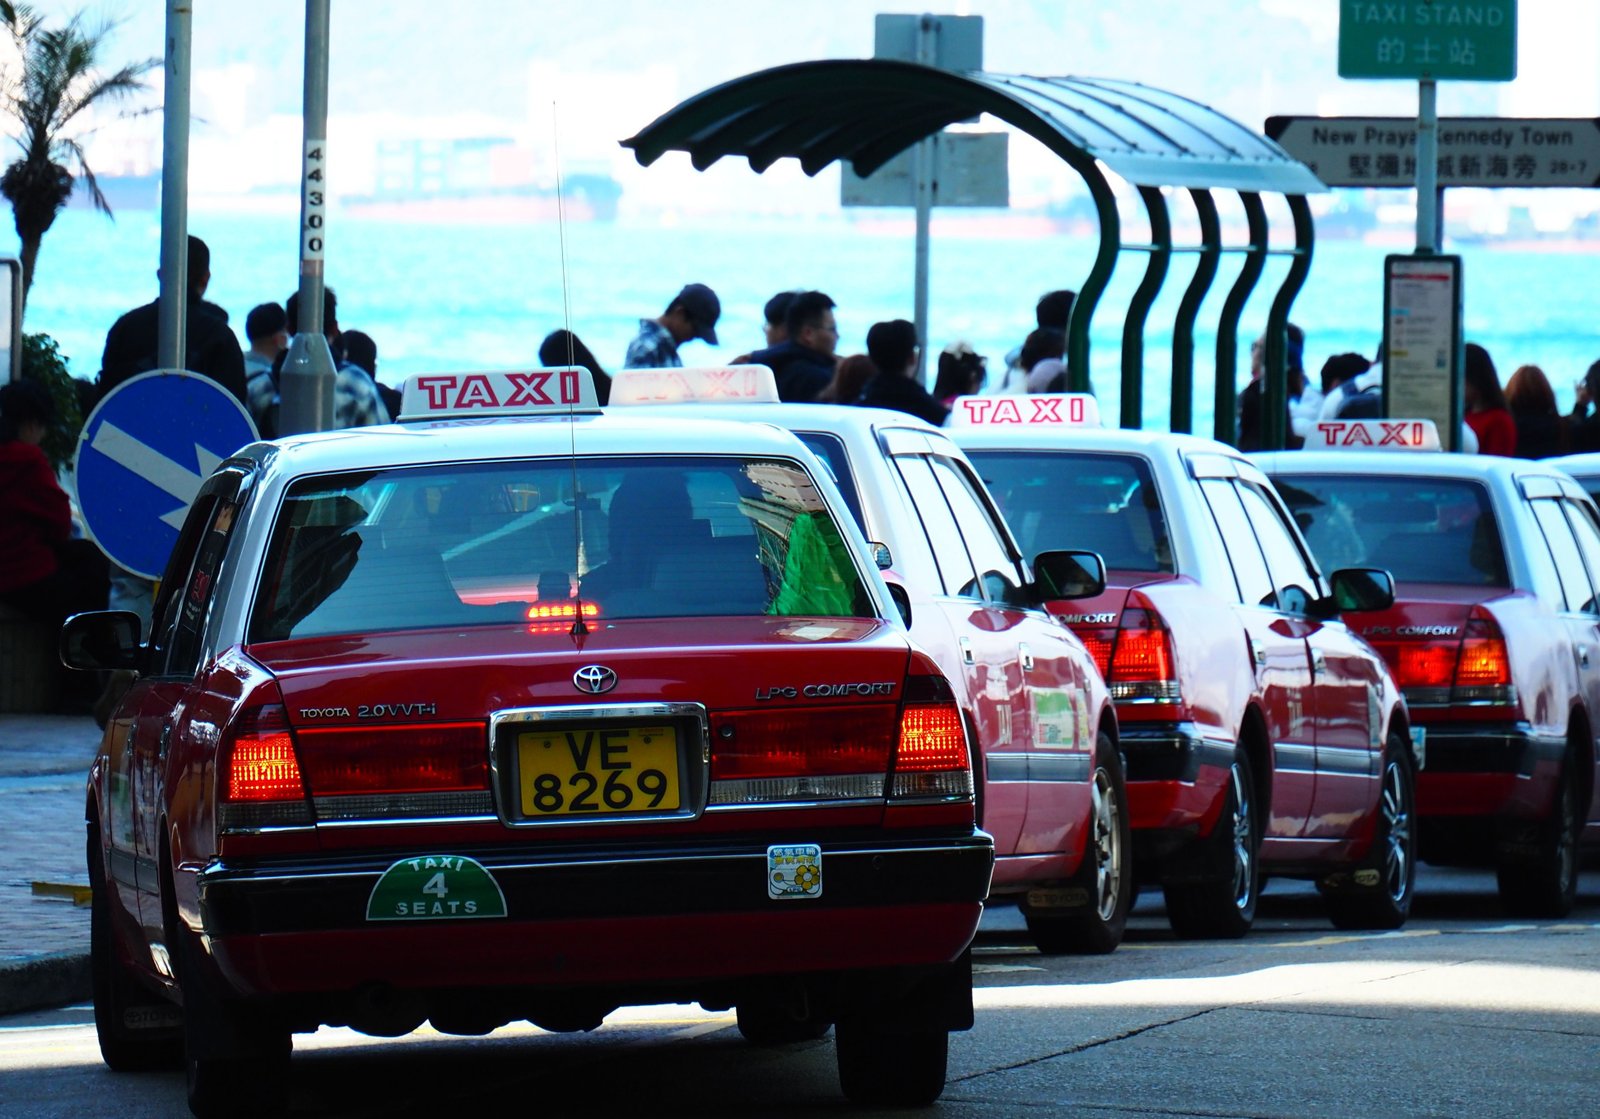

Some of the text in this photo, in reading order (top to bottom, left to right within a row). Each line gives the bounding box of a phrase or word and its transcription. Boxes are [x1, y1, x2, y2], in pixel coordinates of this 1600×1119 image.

[1352, 4, 1503, 26] TAXI STAND
[1377, 37, 1476, 65] 的士站
[1312, 126, 1357, 145] New
[1520, 126, 1573, 145] Town
[307, 147, 323, 252] 44300
[418, 371, 580, 409] TAXI
[625, 369, 757, 400] TAXI
[963, 398, 1083, 424] TAXI
[1318, 422, 1423, 446] TAXI
[1396, 625, 1458, 636] COMFORT
[755, 682, 896, 700] LPG COMFORT
[300, 708, 350, 718] TOYOTA
[565, 730, 632, 771] VE
[533, 769, 667, 812] 8269
[408, 857, 463, 872] TAXI
[422, 872, 448, 898] 4
[395, 901, 477, 915] SEATS
